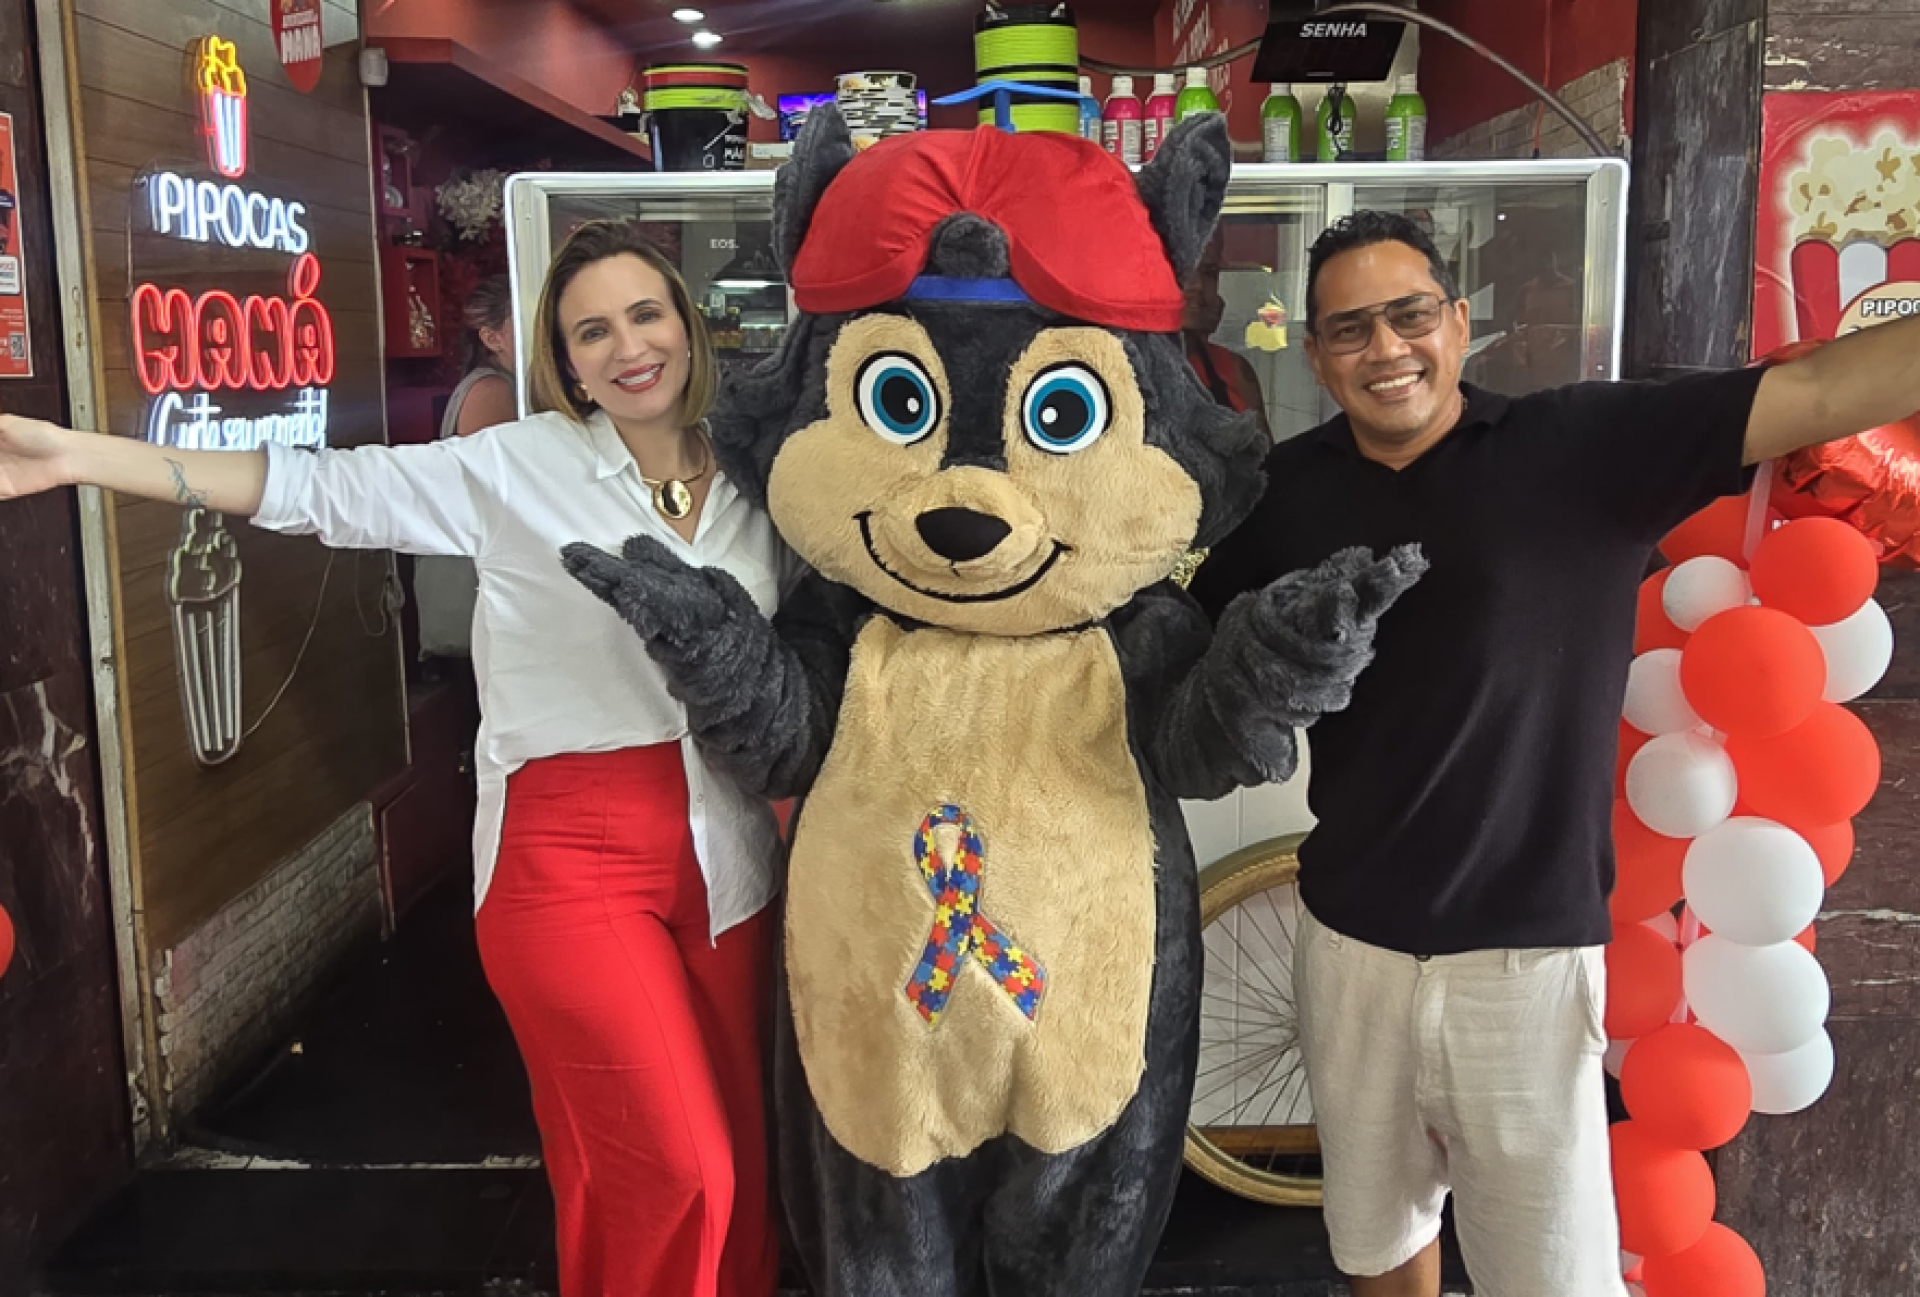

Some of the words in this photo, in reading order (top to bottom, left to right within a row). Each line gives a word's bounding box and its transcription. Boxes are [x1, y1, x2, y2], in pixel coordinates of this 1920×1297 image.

[1299, 22, 1368, 38] SENHA
[156, 172, 309, 254] PIPOCAS
[131, 252, 335, 395] MANÁ
